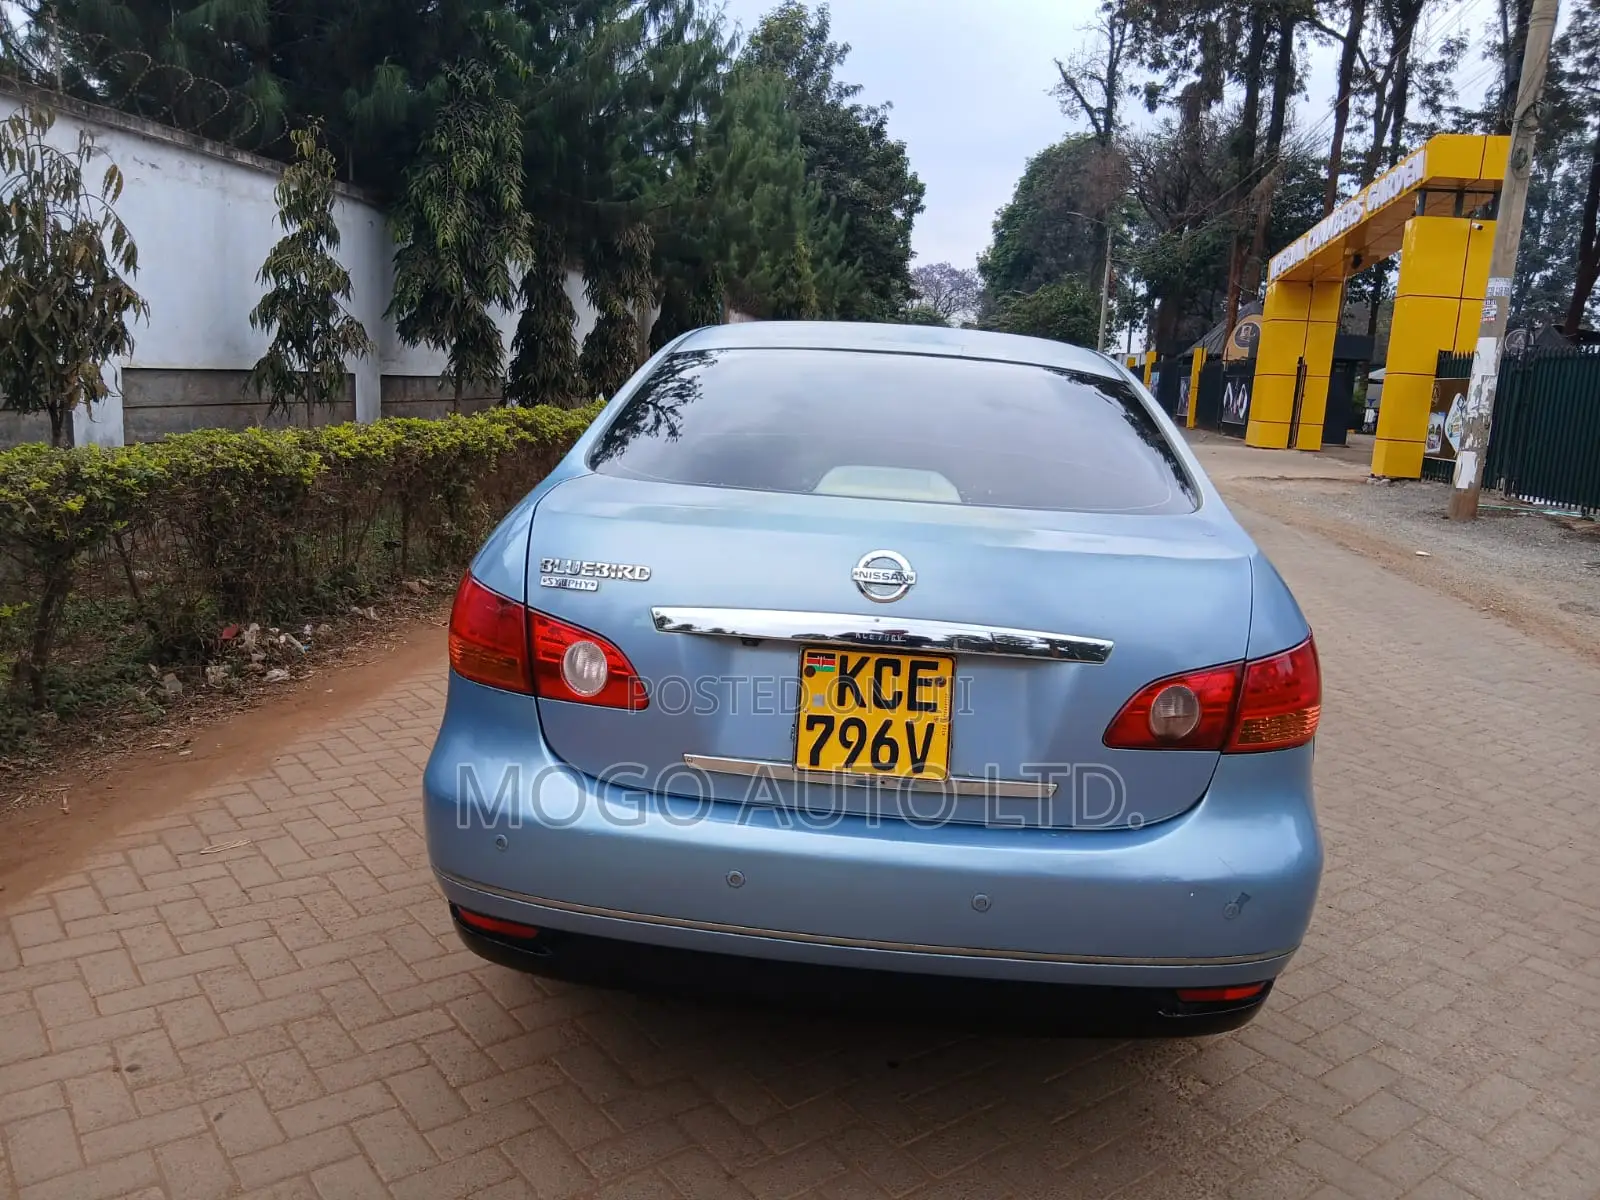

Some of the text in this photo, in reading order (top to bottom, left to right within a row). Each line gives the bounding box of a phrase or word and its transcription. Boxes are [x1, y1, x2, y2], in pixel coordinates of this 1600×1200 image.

[540, 558, 651, 581] BLUEBIRD
[859, 570, 909, 582] NISSAN
[546, 577, 592, 589] SYLPHY
[837, 655, 939, 712] KCE
[806, 715, 935, 774] 796V
